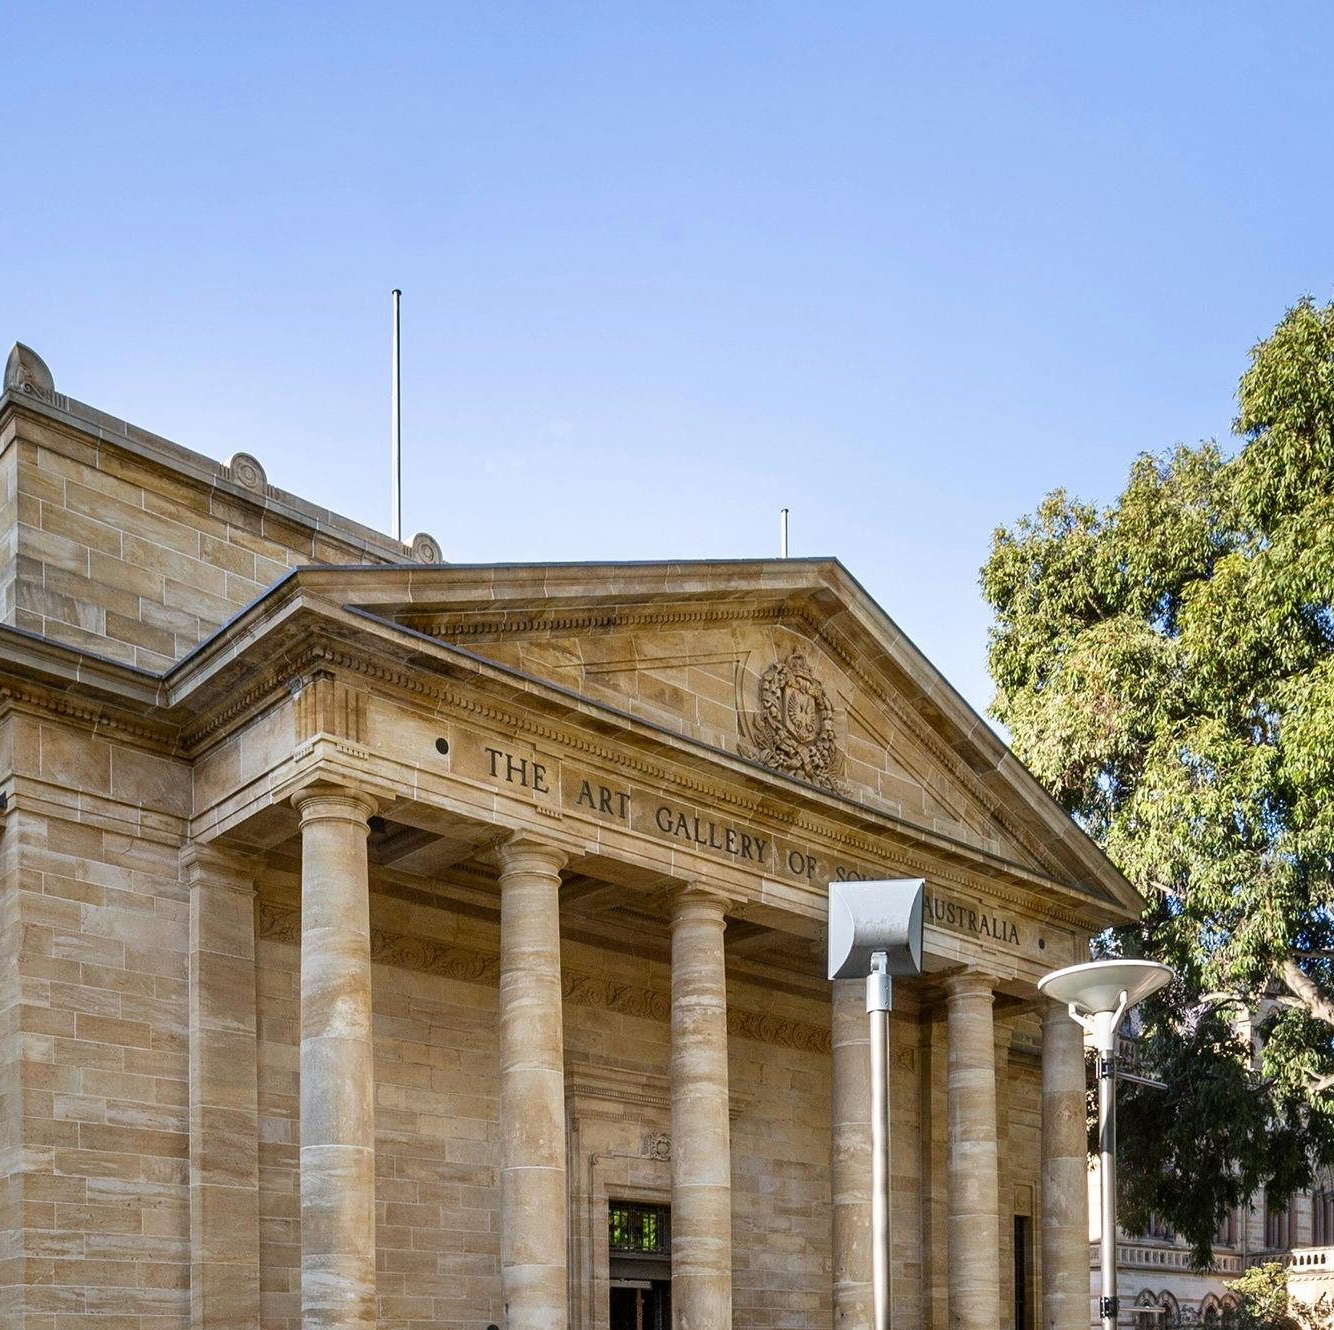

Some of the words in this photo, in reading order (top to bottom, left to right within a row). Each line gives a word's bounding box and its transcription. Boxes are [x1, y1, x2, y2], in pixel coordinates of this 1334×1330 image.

[484, 746, 549, 794] THE
[576, 779, 632, 820] ART
[655, 806, 767, 864] GALLERY
[788, 850, 818, 879] OF
